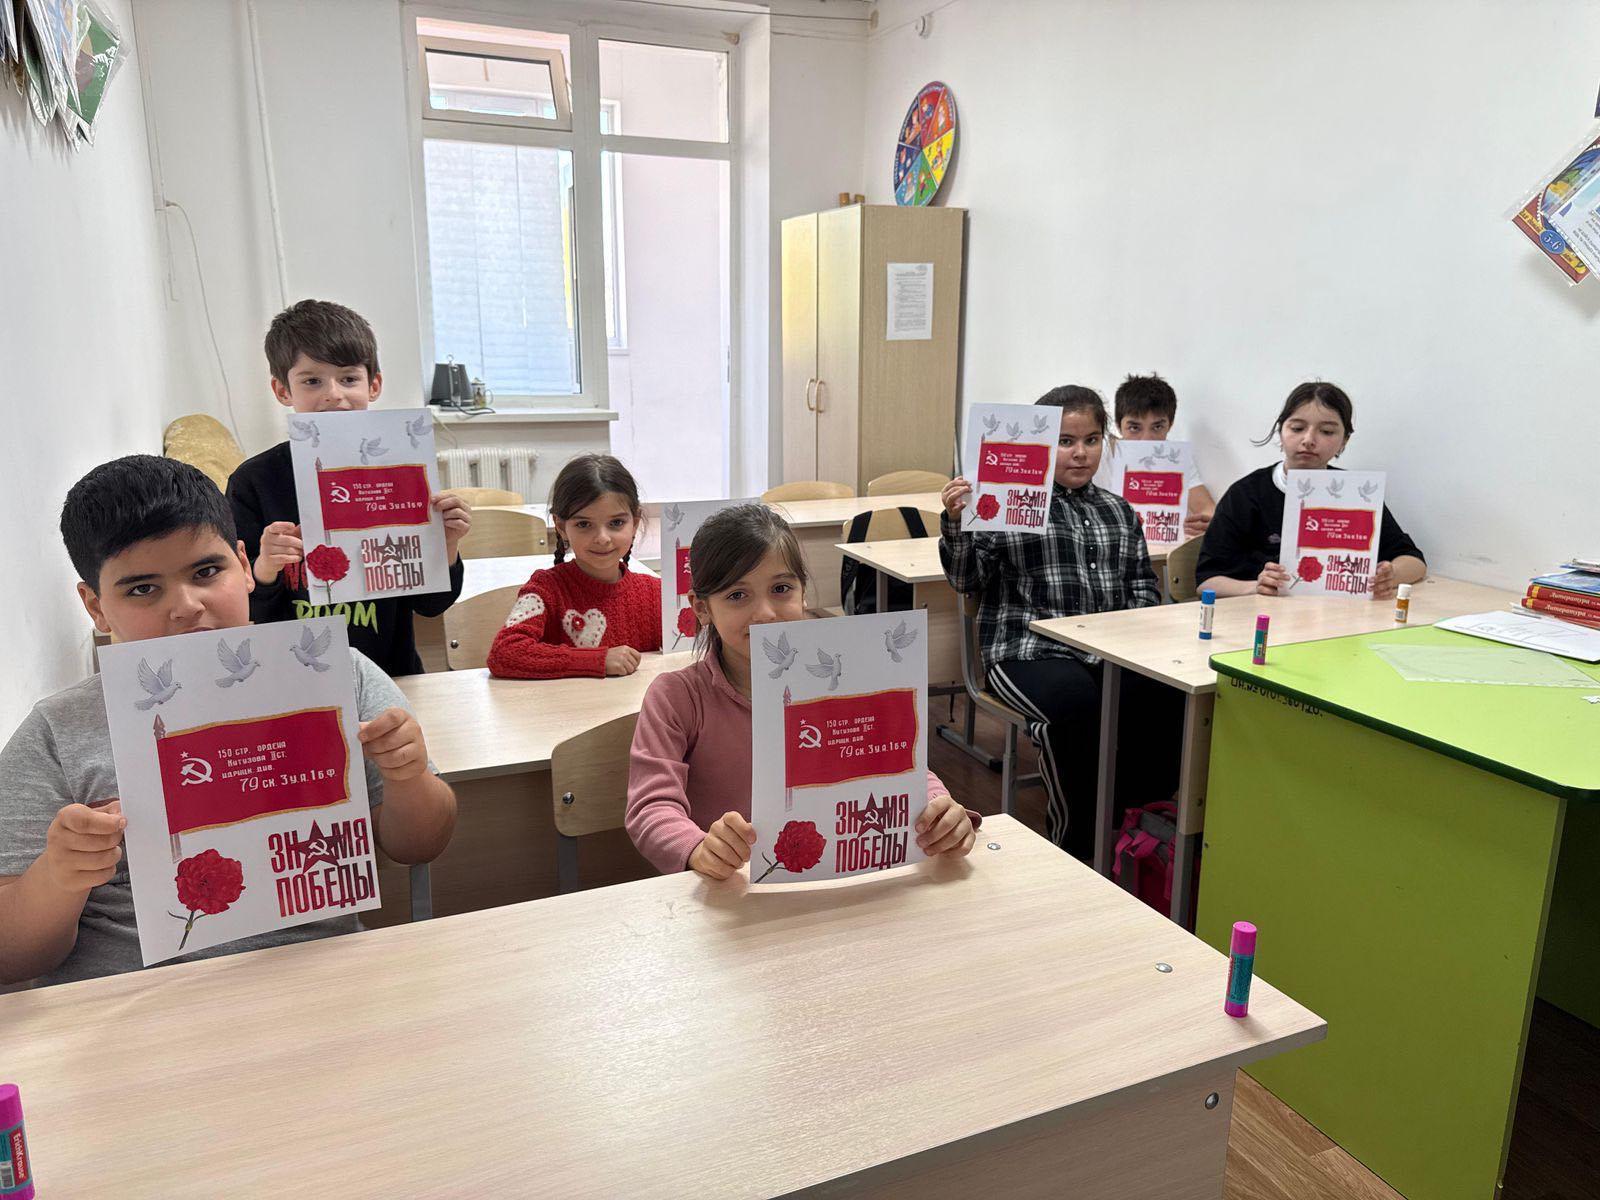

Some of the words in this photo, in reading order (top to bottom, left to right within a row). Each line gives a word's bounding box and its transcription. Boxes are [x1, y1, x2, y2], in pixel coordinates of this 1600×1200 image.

[1006, 488, 1047, 509] ЗНАМЯ
[1006, 508, 1045, 528] ПОБЕДЫ
[360, 533, 421, 566] ЗНАМЯ
[1327, 554, 1371, 574] ЗНАМЯ
[364, 562, 425, 592] ПОБЕДЫ
[1325, 573, 1368, 594] ПОБЕДЫ
[826, 720, 837, 728] 150
[218, 748, 233, 759] 150
[840, 745, 853, 758] 79
[240, 776, 259, 792] 79
[835, 792, 909, 838] ЗНАМЯ
[267, 817, 370, 875] ЗНАМЯ
[835, 831, 908, 873] ПОБЕДЫ
[276, 860, 375, 918] ПОБЕДЫ
